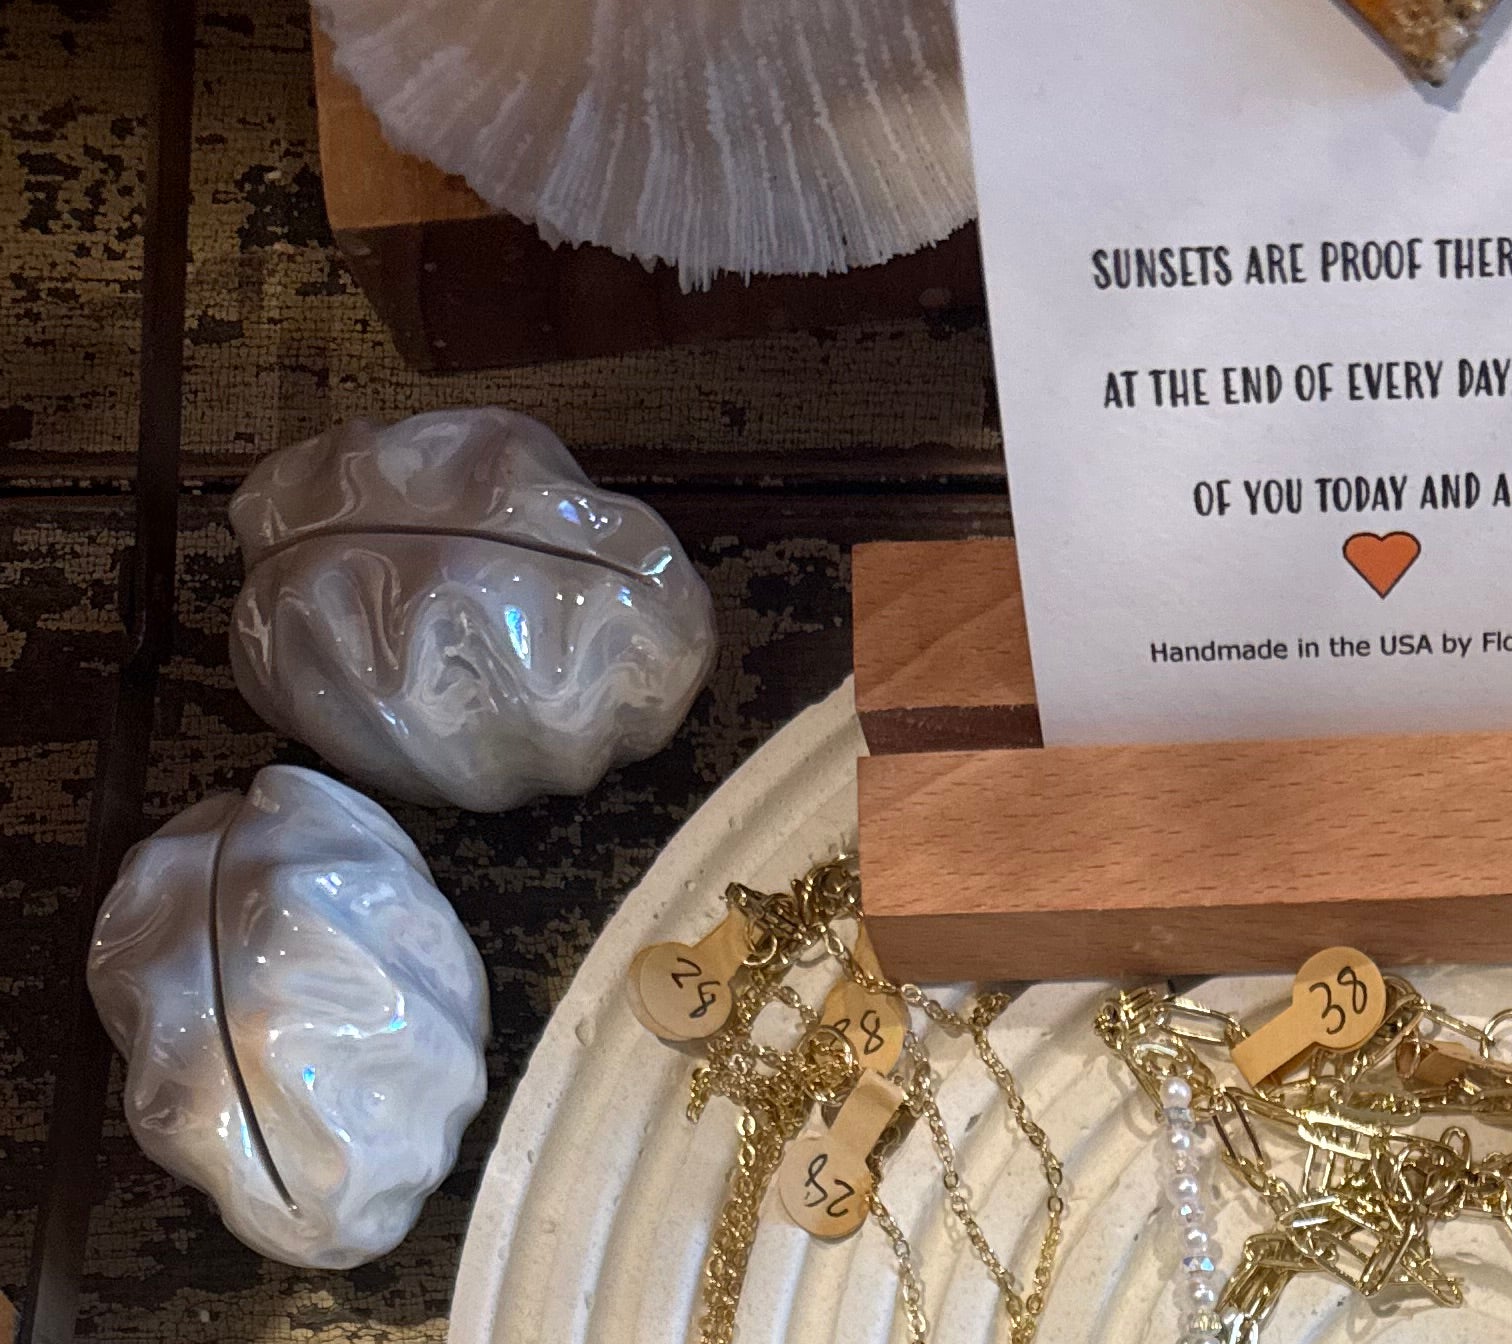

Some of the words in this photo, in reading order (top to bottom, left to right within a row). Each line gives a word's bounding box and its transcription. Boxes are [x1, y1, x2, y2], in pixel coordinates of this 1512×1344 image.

[1091, 245, 1233, 291] SUNSETS
[1244, 242, 1307, 285] ARE
[1320, 238, 1423, 283] PROOF
[1103, 369, 1140, 409] AT
[1148, 367, 1210, 408] THE
[1222, 364, 1283, 405] END
[1294, 362, 1334, 403] OF
[1347, 360, 1444, 402] EVERY
[1193, 479, 1232, 517] OF
[1243, 478, 1303, 516] YOU
[1314, 474, 1408, 513] TODAY
[1419, 471, 1481, 510] AND
[1150, 638, 1289, 663] Handmade
[1298, 637, 1320, 659] in
[1329, 635, 1371, 658] the
[1379, 633, 1434, 657] USA
[1442, 632, 1473, 658] by
[1308, 965, 1368, 1035] 38
